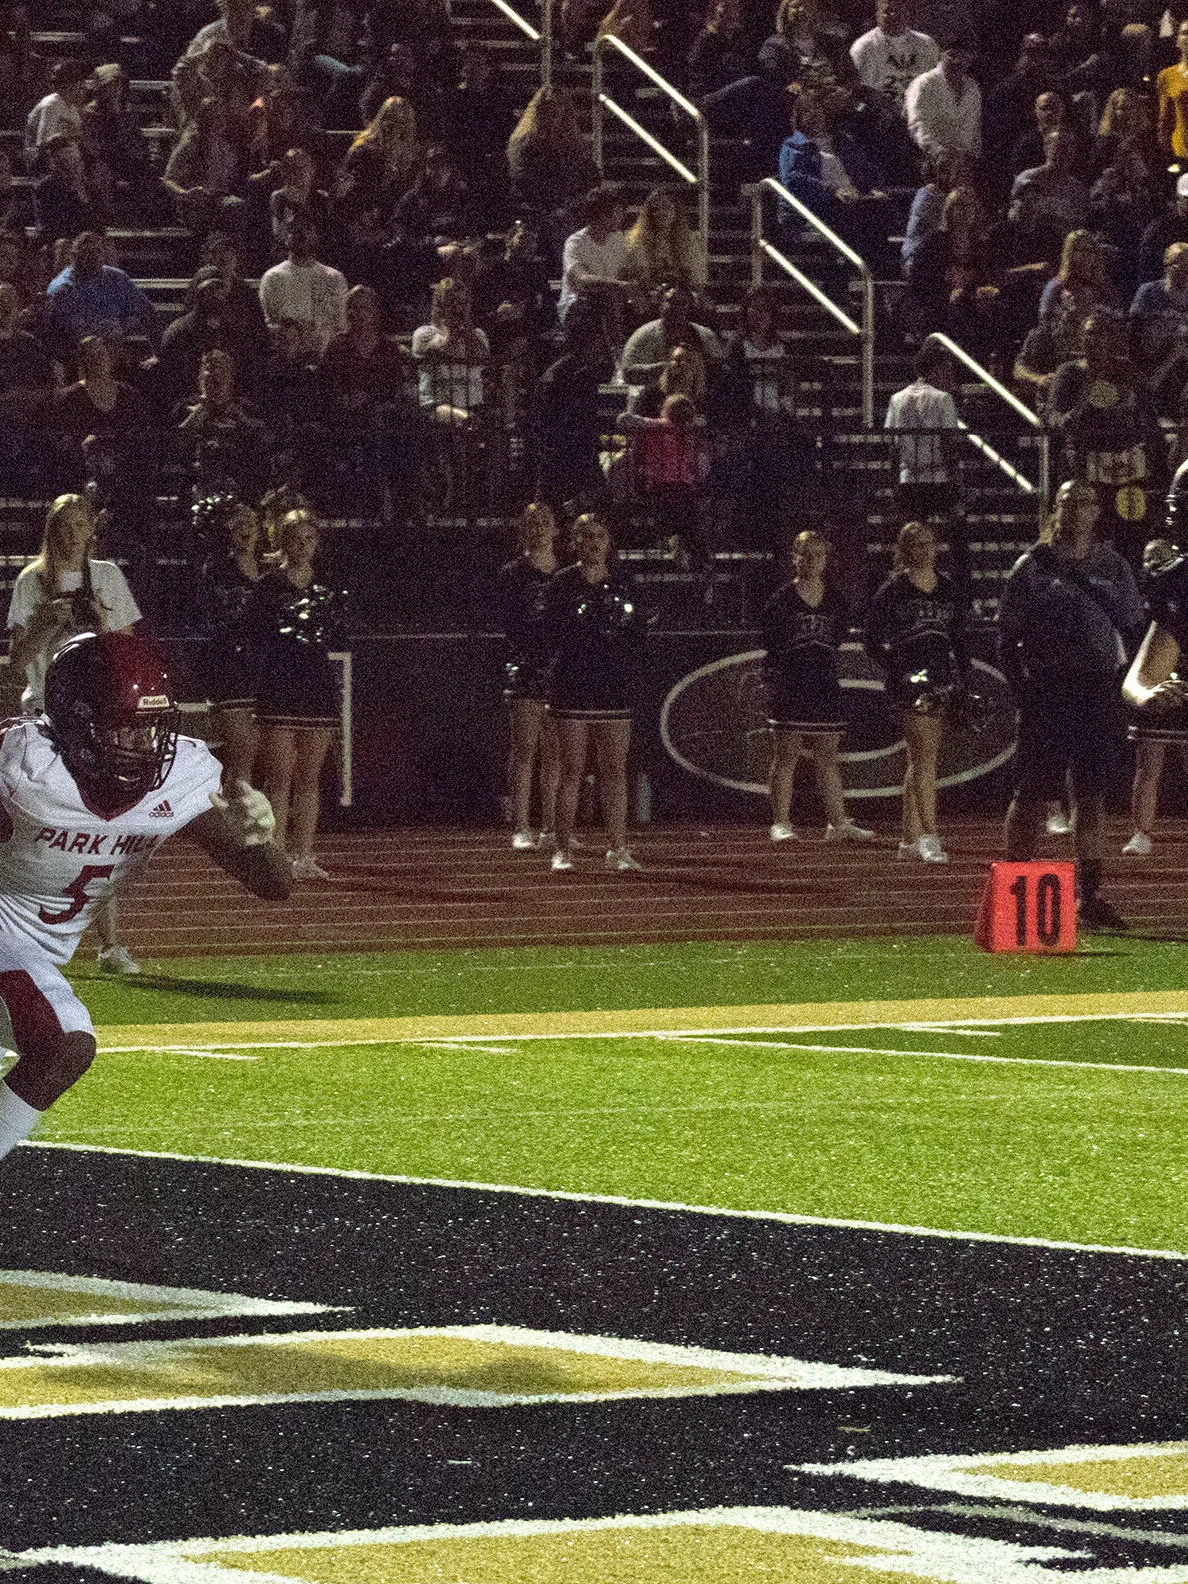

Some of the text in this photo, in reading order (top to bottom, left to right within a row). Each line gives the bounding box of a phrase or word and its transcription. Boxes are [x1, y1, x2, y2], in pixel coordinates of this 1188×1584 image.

[34, 827, 163, 856] PARK HILL
[38, 864, 114, 925] 5
[1010, 873, 1061, 947] 10
